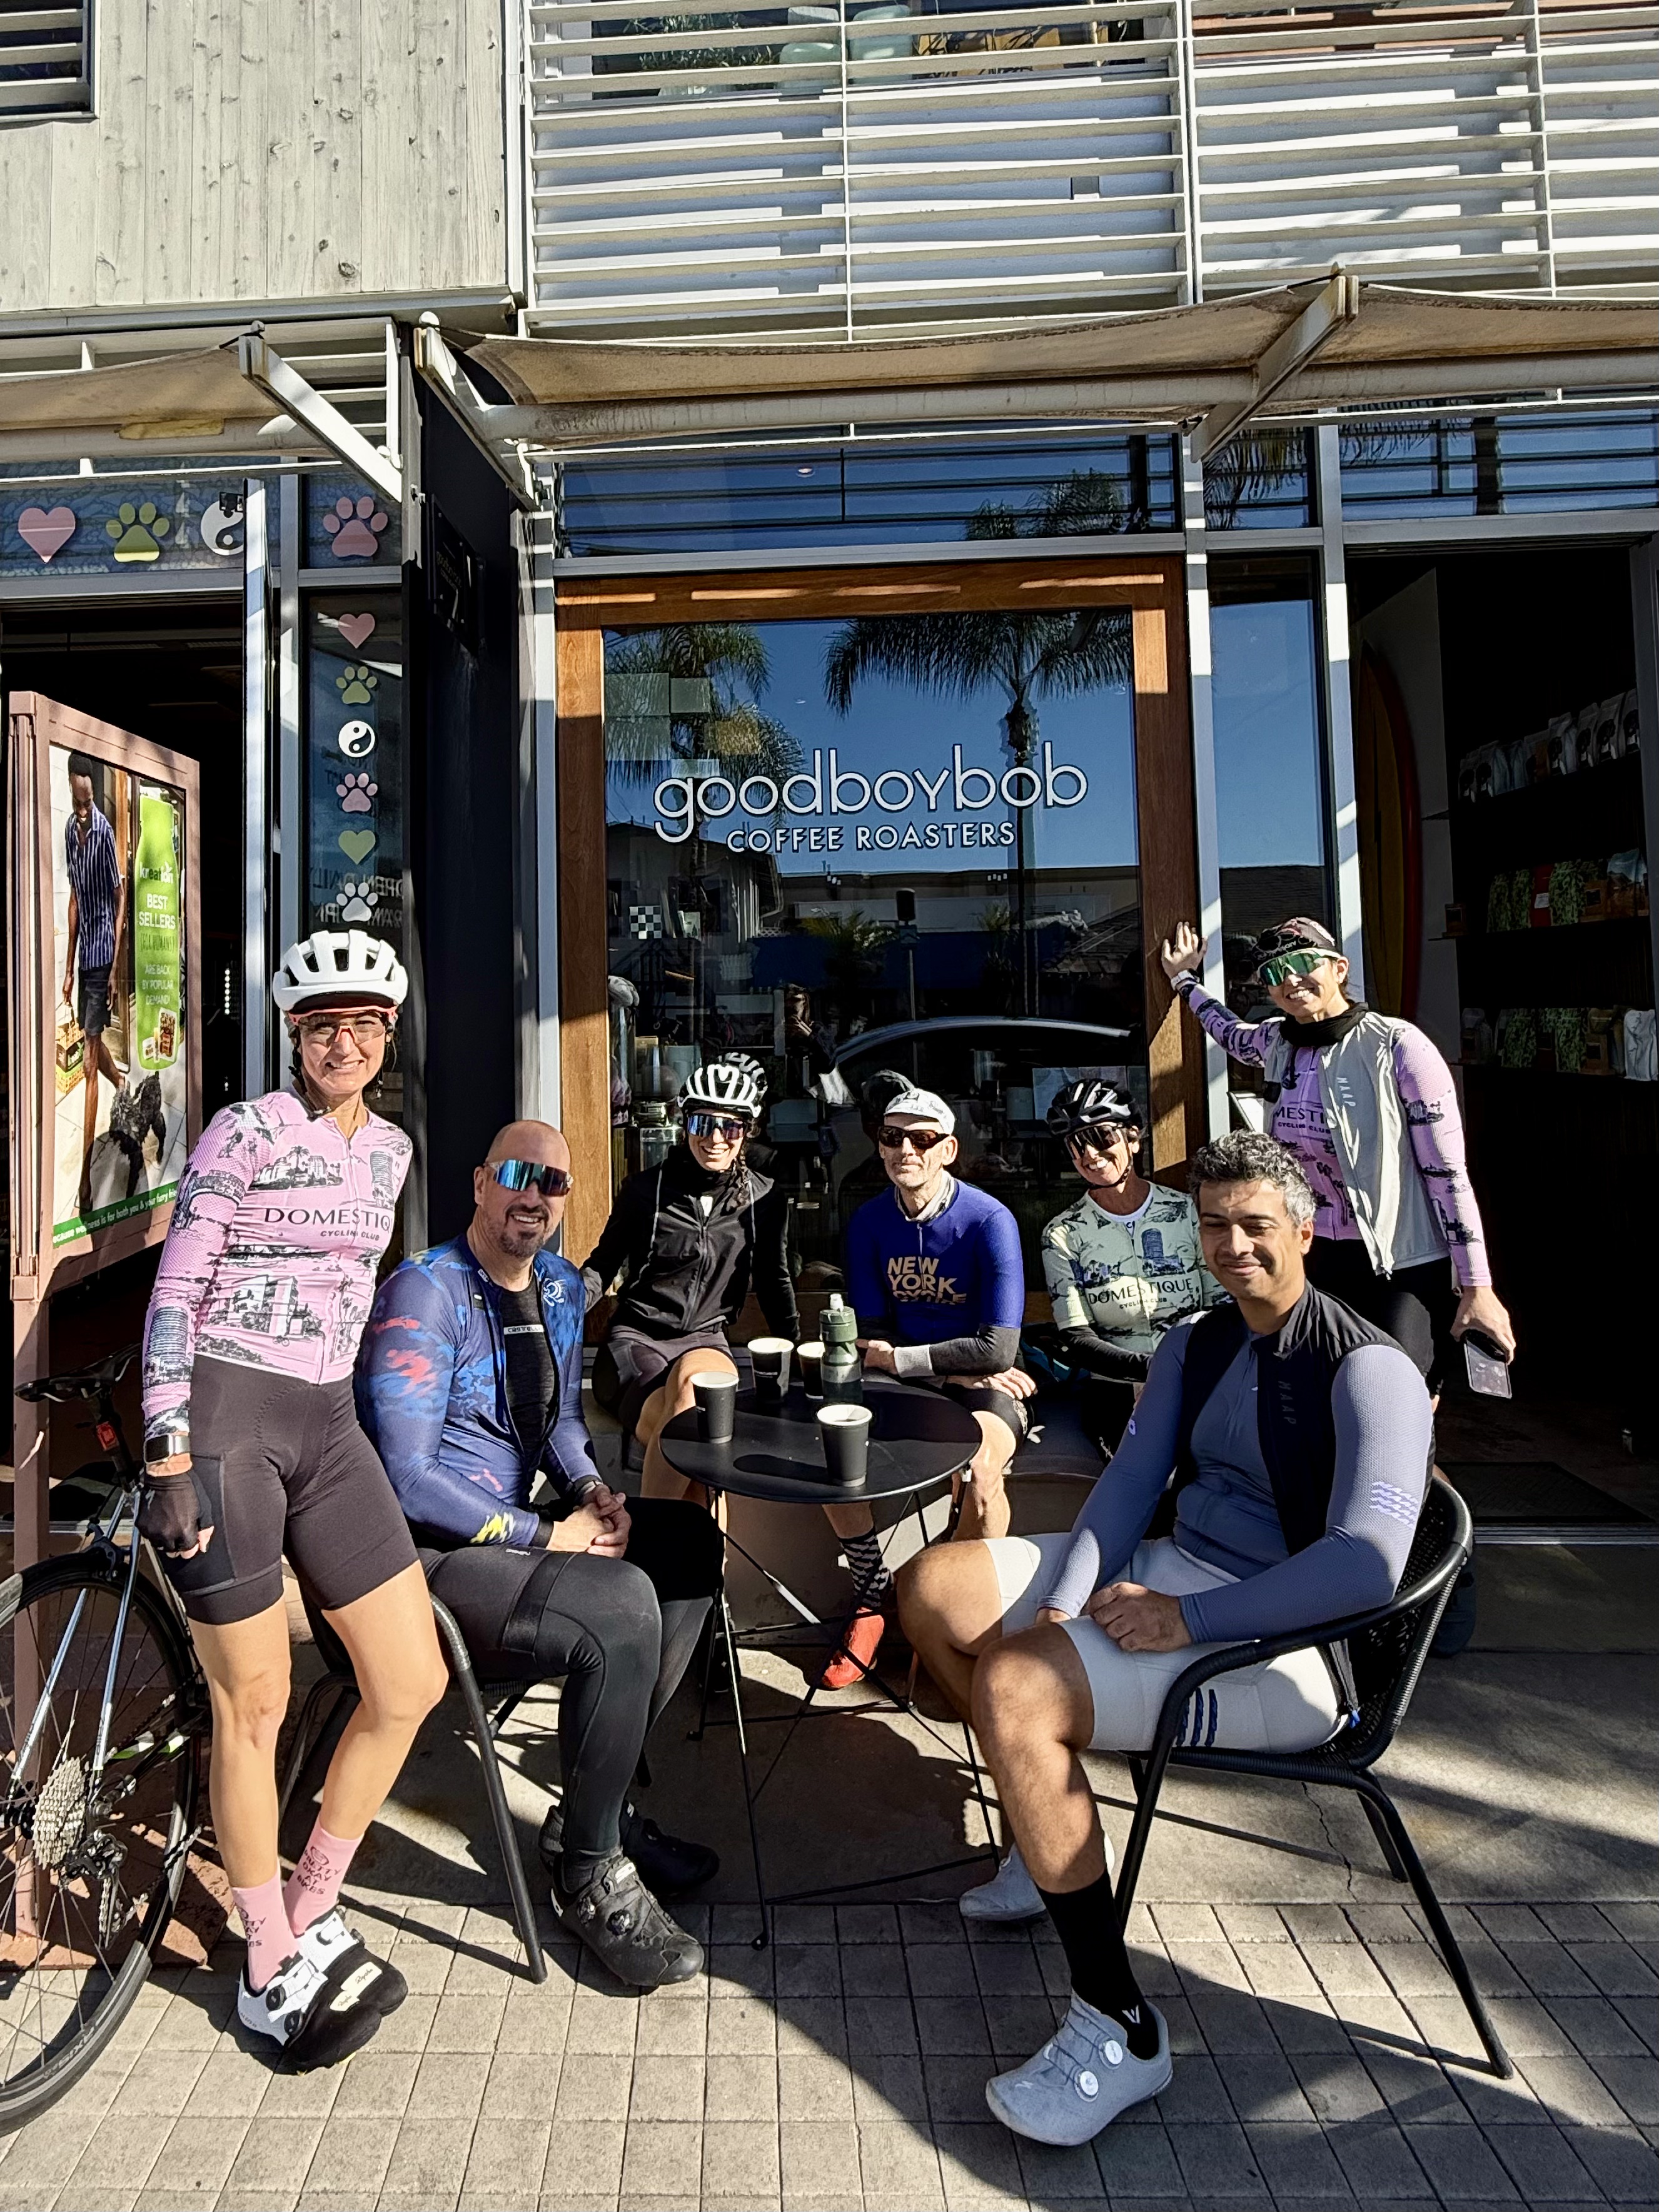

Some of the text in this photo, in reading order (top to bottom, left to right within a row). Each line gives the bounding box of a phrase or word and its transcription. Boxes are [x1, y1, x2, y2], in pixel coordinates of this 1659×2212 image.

[653, 740, 1088, 843] goodboybob
[727, 821, 1015, 853] COFFEE ROASTERS
[146, 893, 168, 911] BEST
[139, 911, 176, 930] SELLERS
[142, 979, 149, 990] BY
[1336, 1077, 1356, 1107] MAAP
[264, 1208, 391, 1234] DOMESTIQ
[361, 1231, 380, 1241] CLUB
[887, 1256, 940, 1275] NEW
[888, 1273, 958, 1295] YORK
[1087, 1278, 1193, 1305] DOMESTIQUE
[1278, 1380, 1296, 1425] MAAP
[302, 1861, 332, 1882] OKAY
